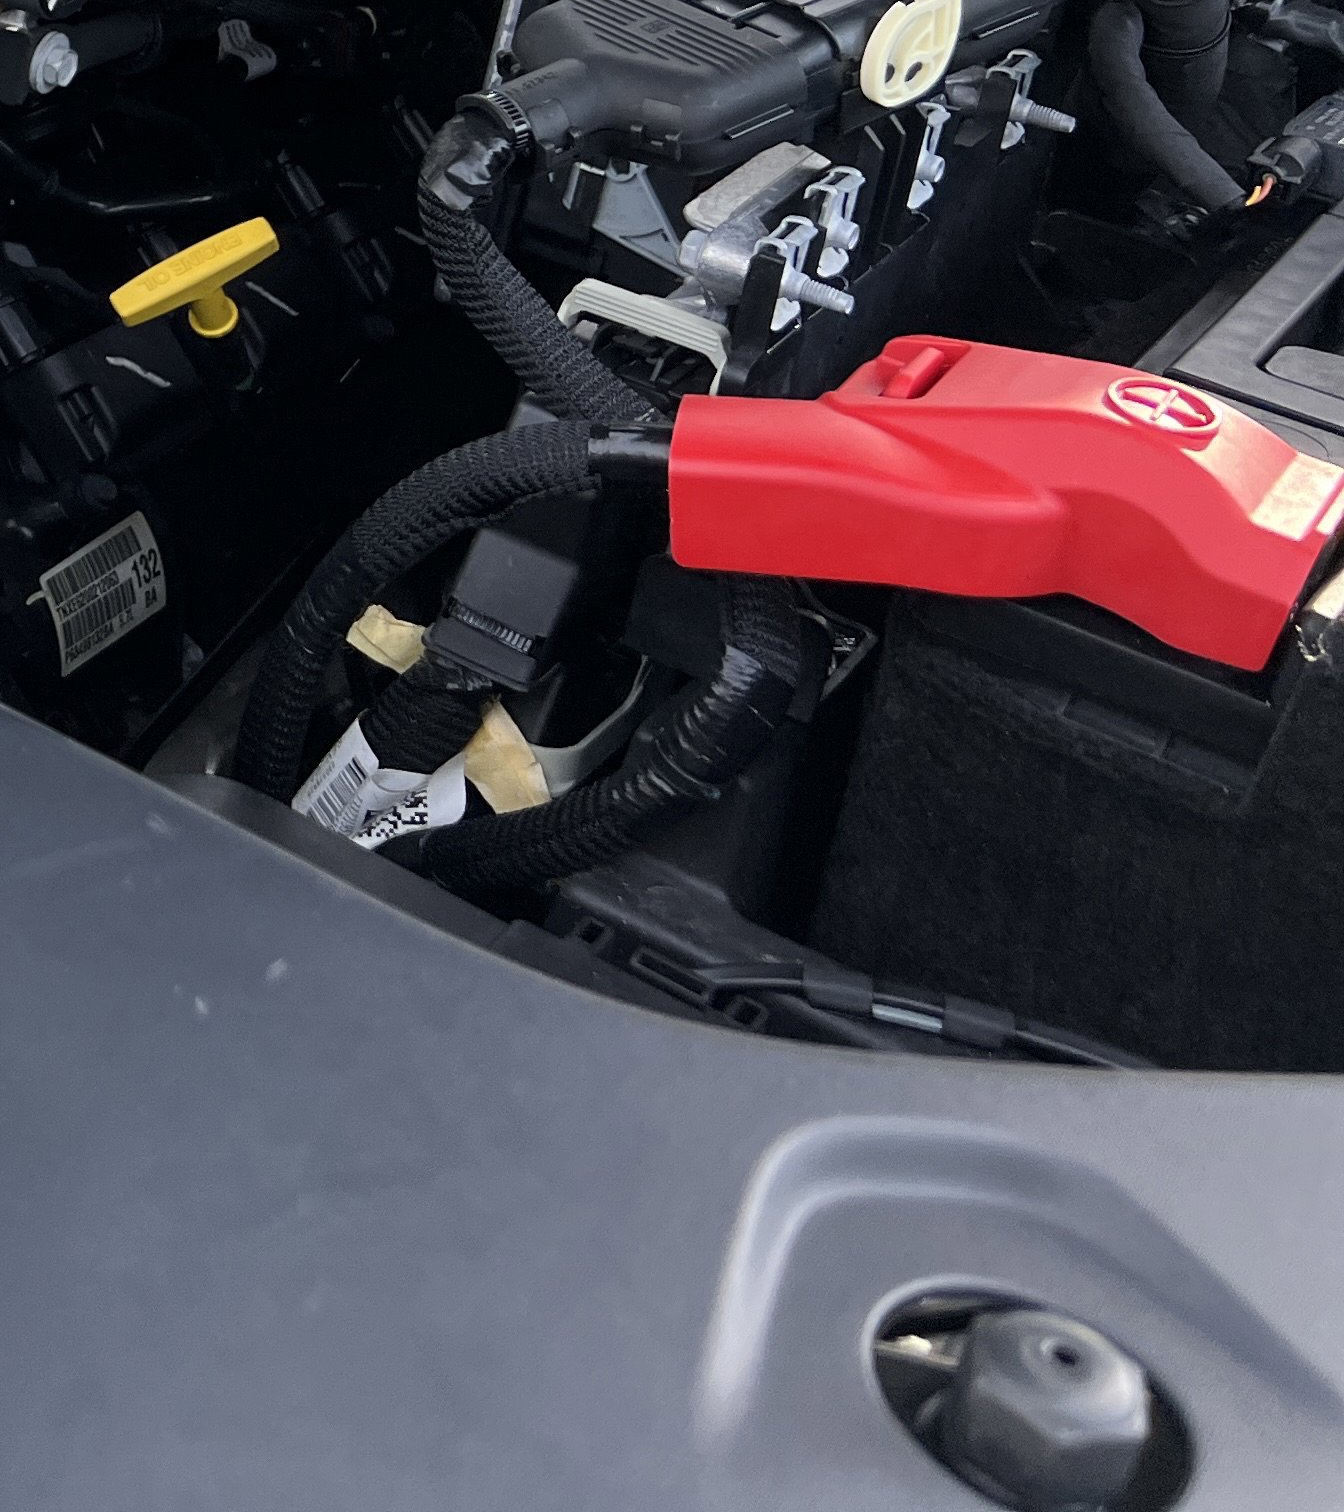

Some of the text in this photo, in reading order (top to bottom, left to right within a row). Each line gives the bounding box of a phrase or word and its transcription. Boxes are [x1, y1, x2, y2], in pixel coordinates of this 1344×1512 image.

[136, 230, 244, 292] ENGINE OIL
[131, 548, 161, 588] 132
